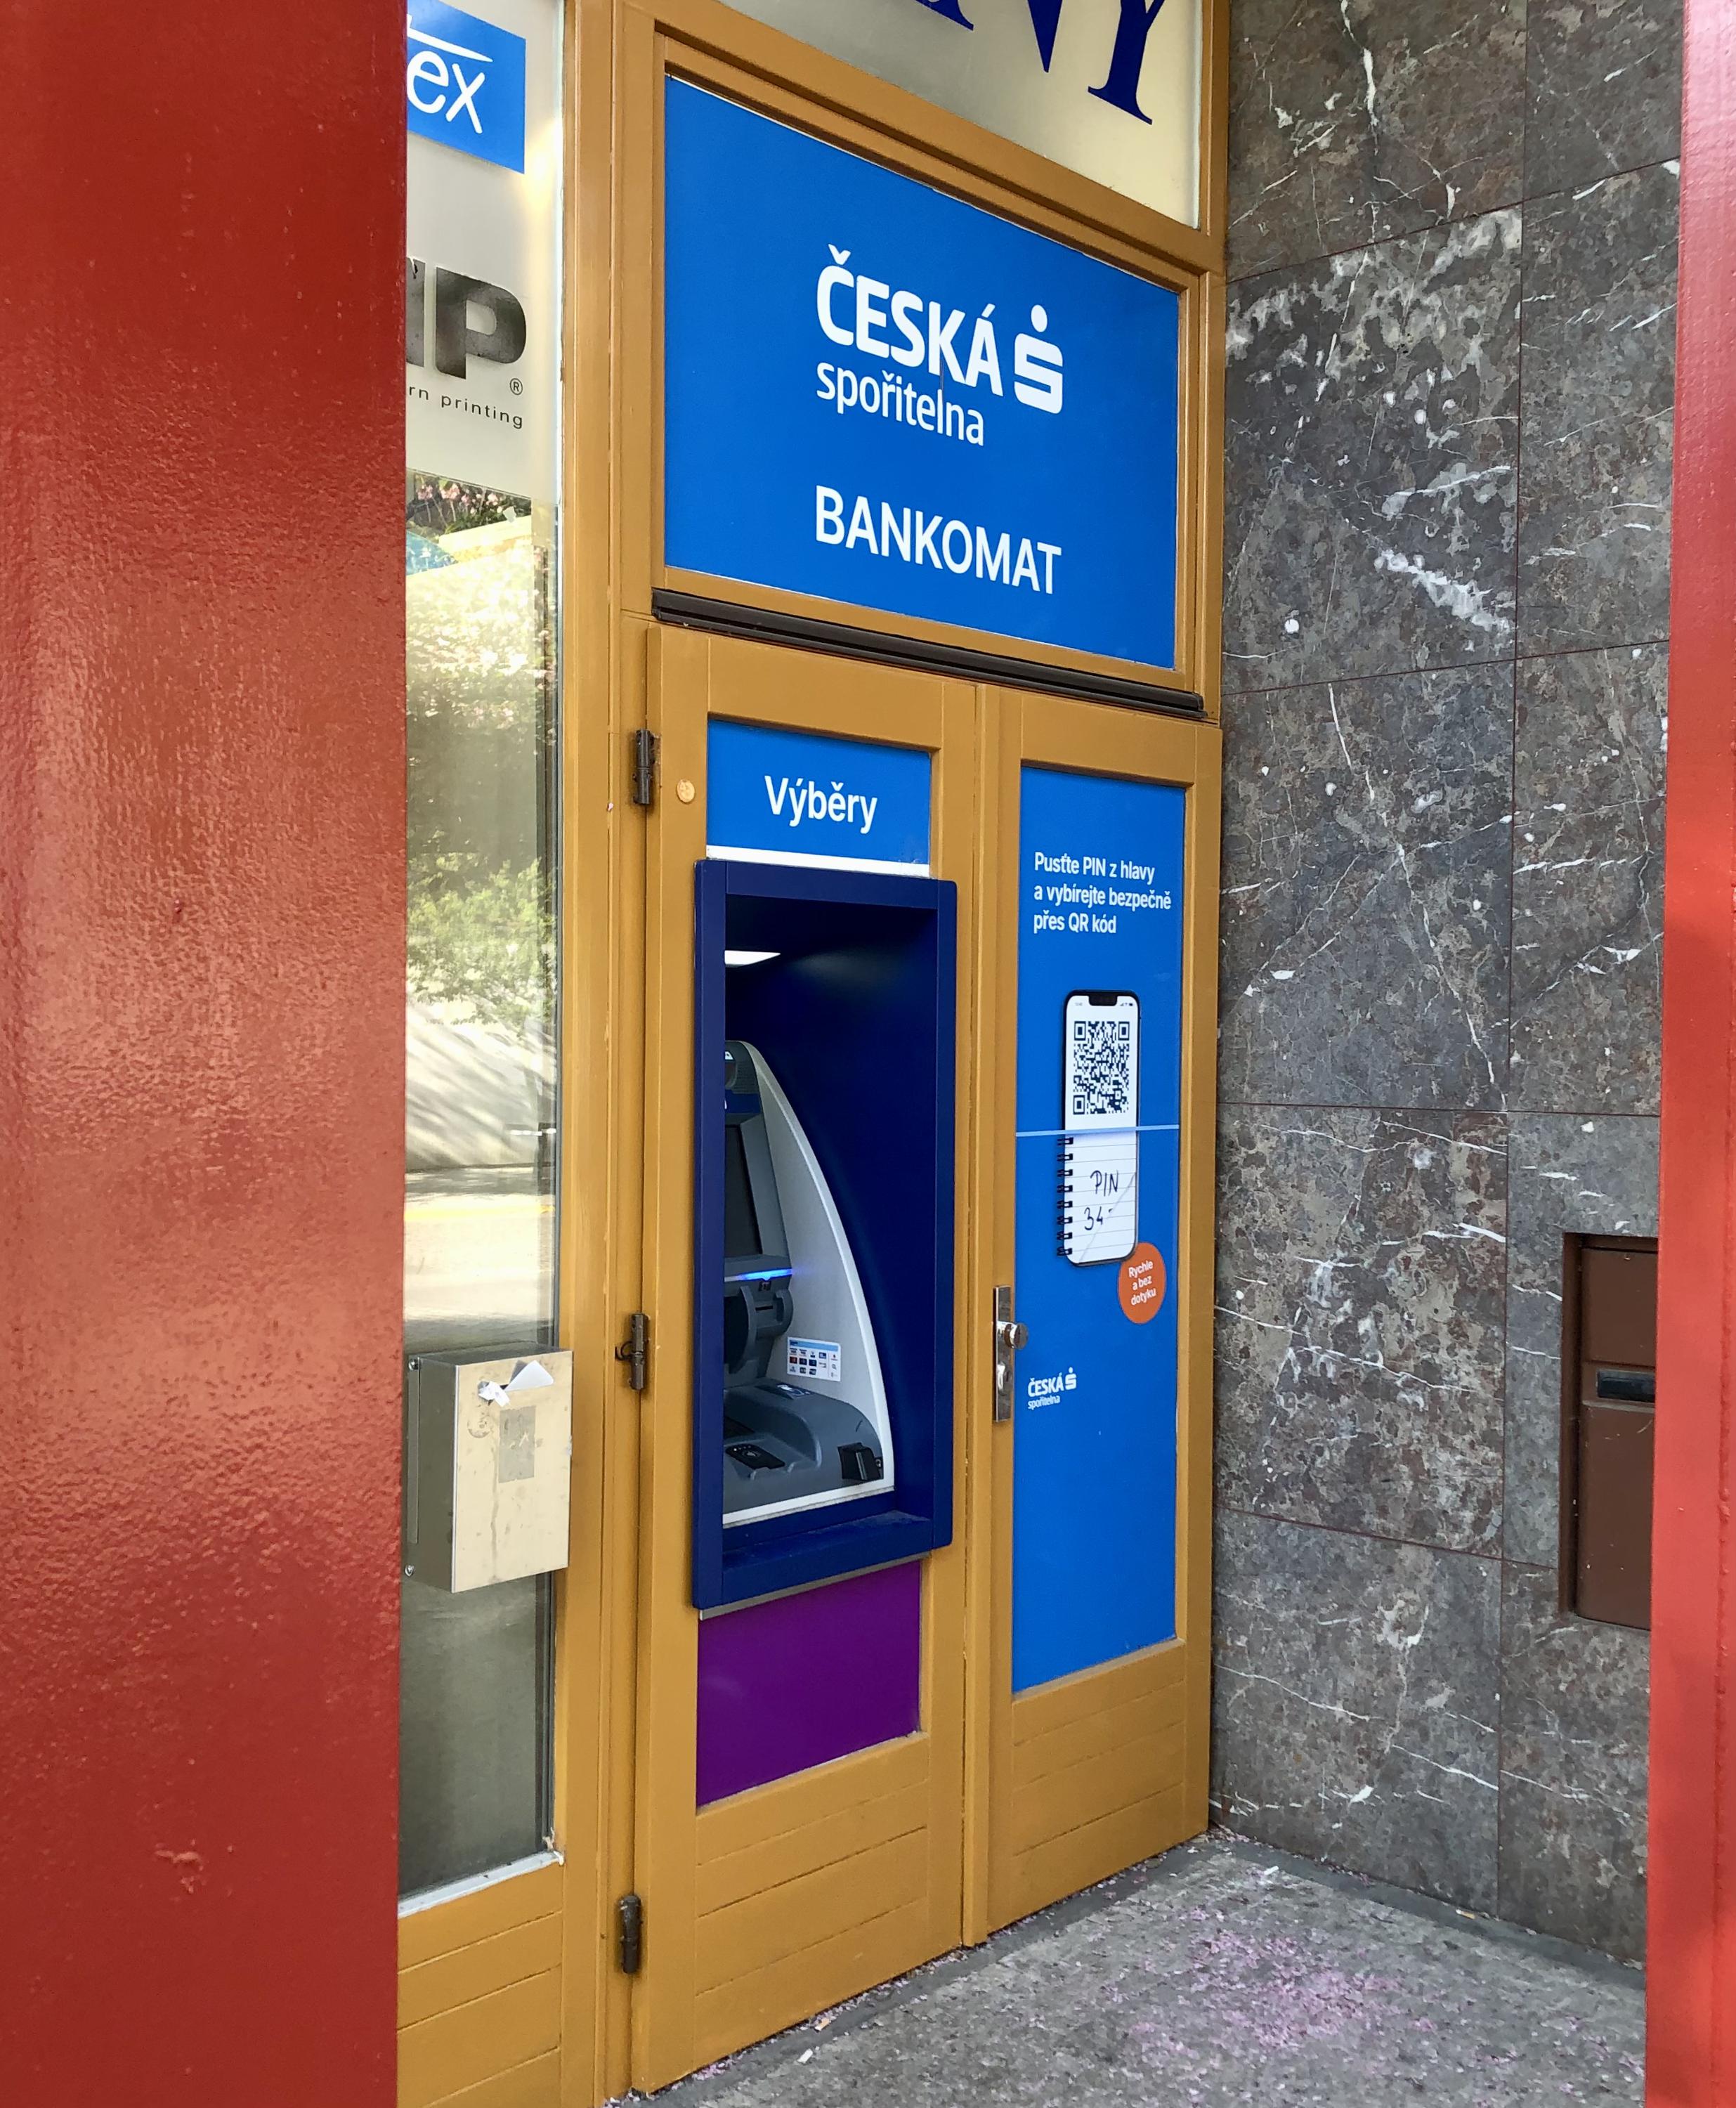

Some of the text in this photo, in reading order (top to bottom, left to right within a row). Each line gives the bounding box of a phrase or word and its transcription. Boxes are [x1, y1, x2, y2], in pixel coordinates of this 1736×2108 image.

[816, 244, 1003, 396] ČESKÁ
[441, 396, 523, 429] printing
[816, 362, 984, 446] spořitelna
[815, 486, 1062, 594] BANKOMAT
[764, 775, 877, 834] Výběry
[1035, 852, 1155, 885] Pusťte PIN z hlavy
[1034, 884, 1172, 912] a vybírejte bezpečně
[1033, 910, 1117, 934] přes QR kód
[1090, 1170, 1119, 1197] PIN
[1128, 1260, 1154, 1278] Rychle
[1132, 1275, 1152, 1291] a bez
[1130, 1288, 1156, 1306] dotyku
[1028, 1372, 1064, 1397] ČESKÁ
